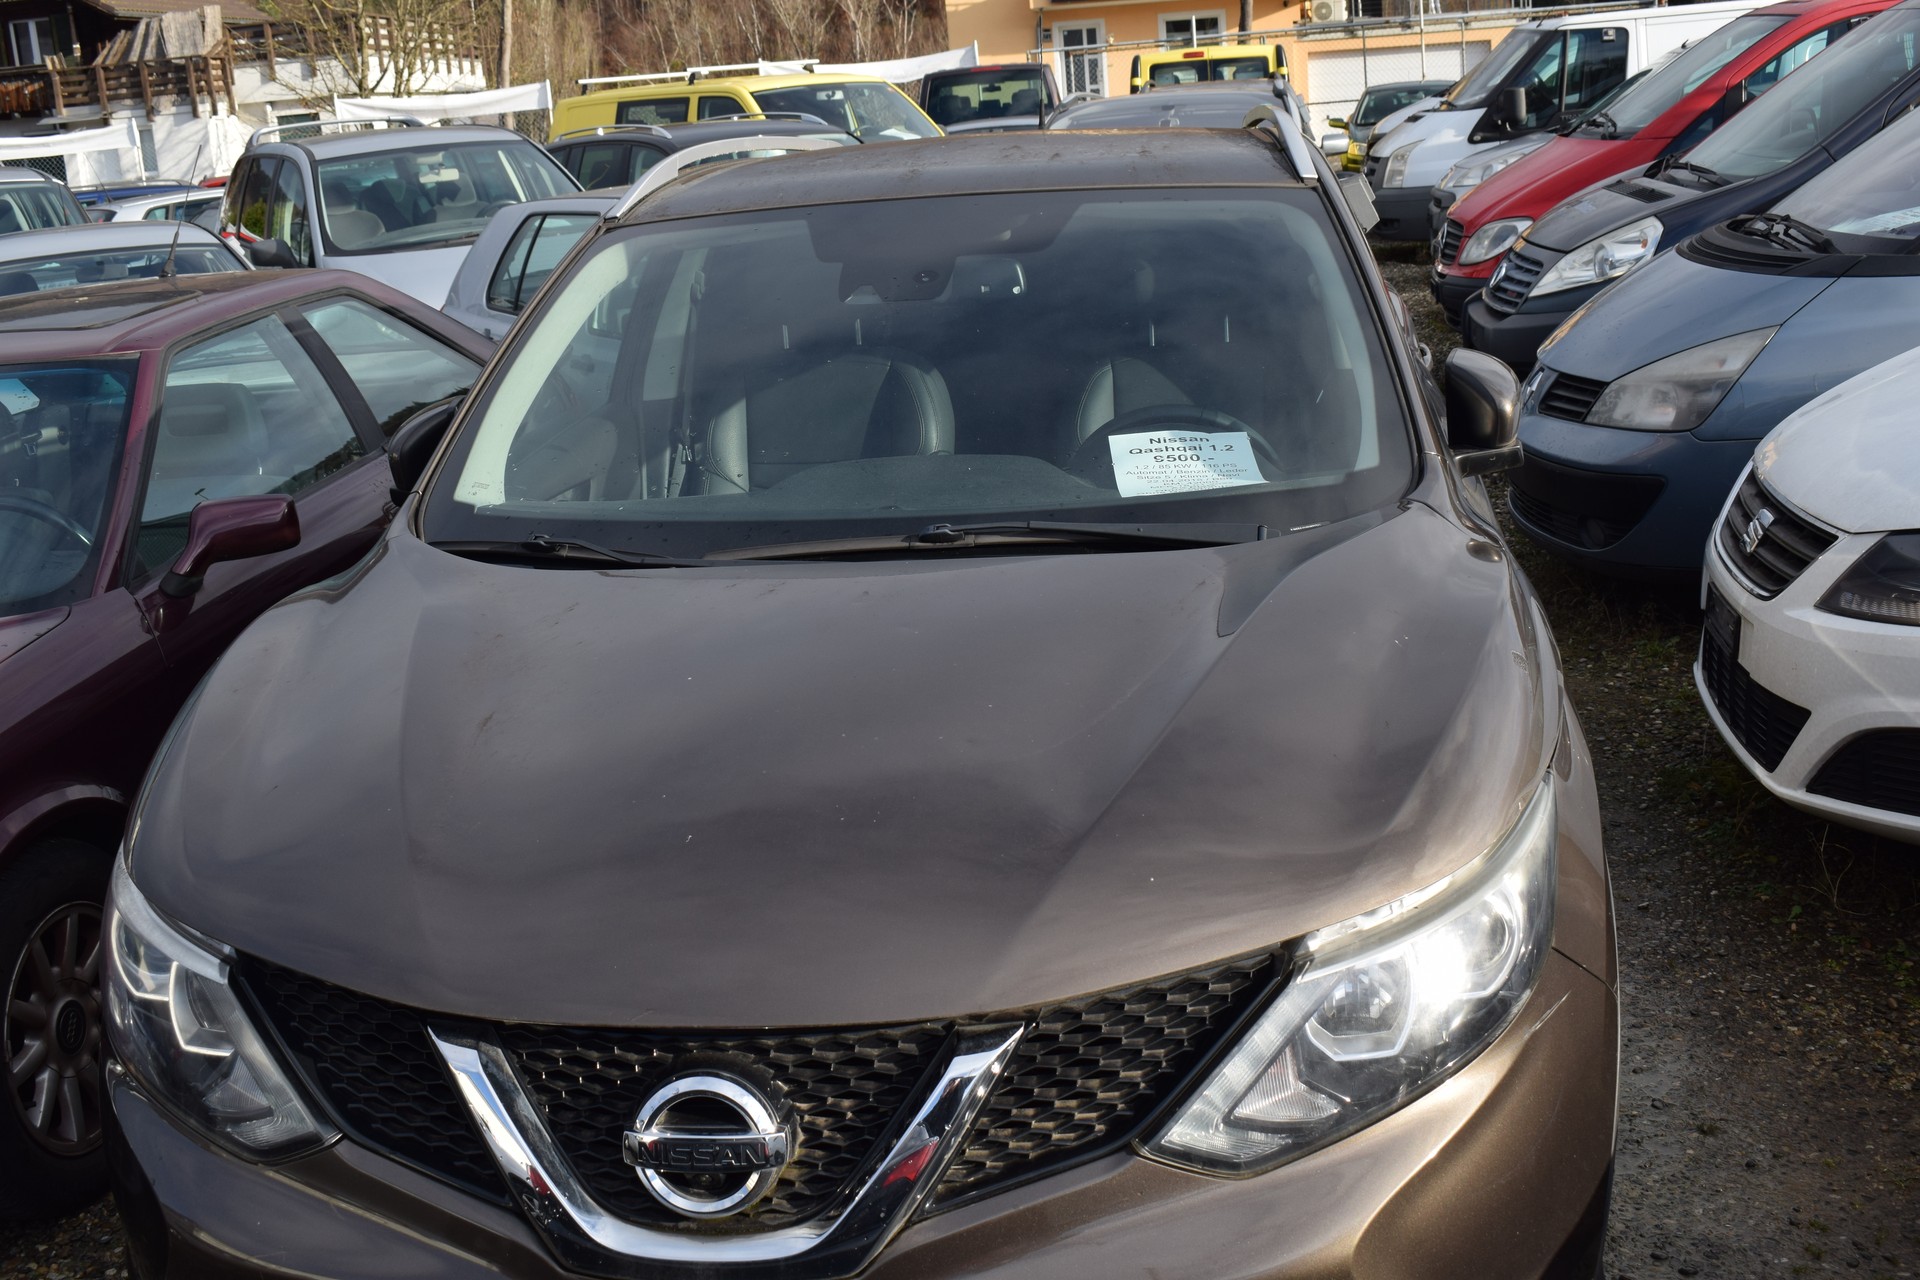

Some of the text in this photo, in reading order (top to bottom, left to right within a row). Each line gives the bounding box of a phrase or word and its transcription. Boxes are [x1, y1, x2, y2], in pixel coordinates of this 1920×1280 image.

[1149, 436, 1210, 444] Nissan
[1129, 444, 1202, 454] Qashqai
[637, 1142, 768, 1166] NISSAN
